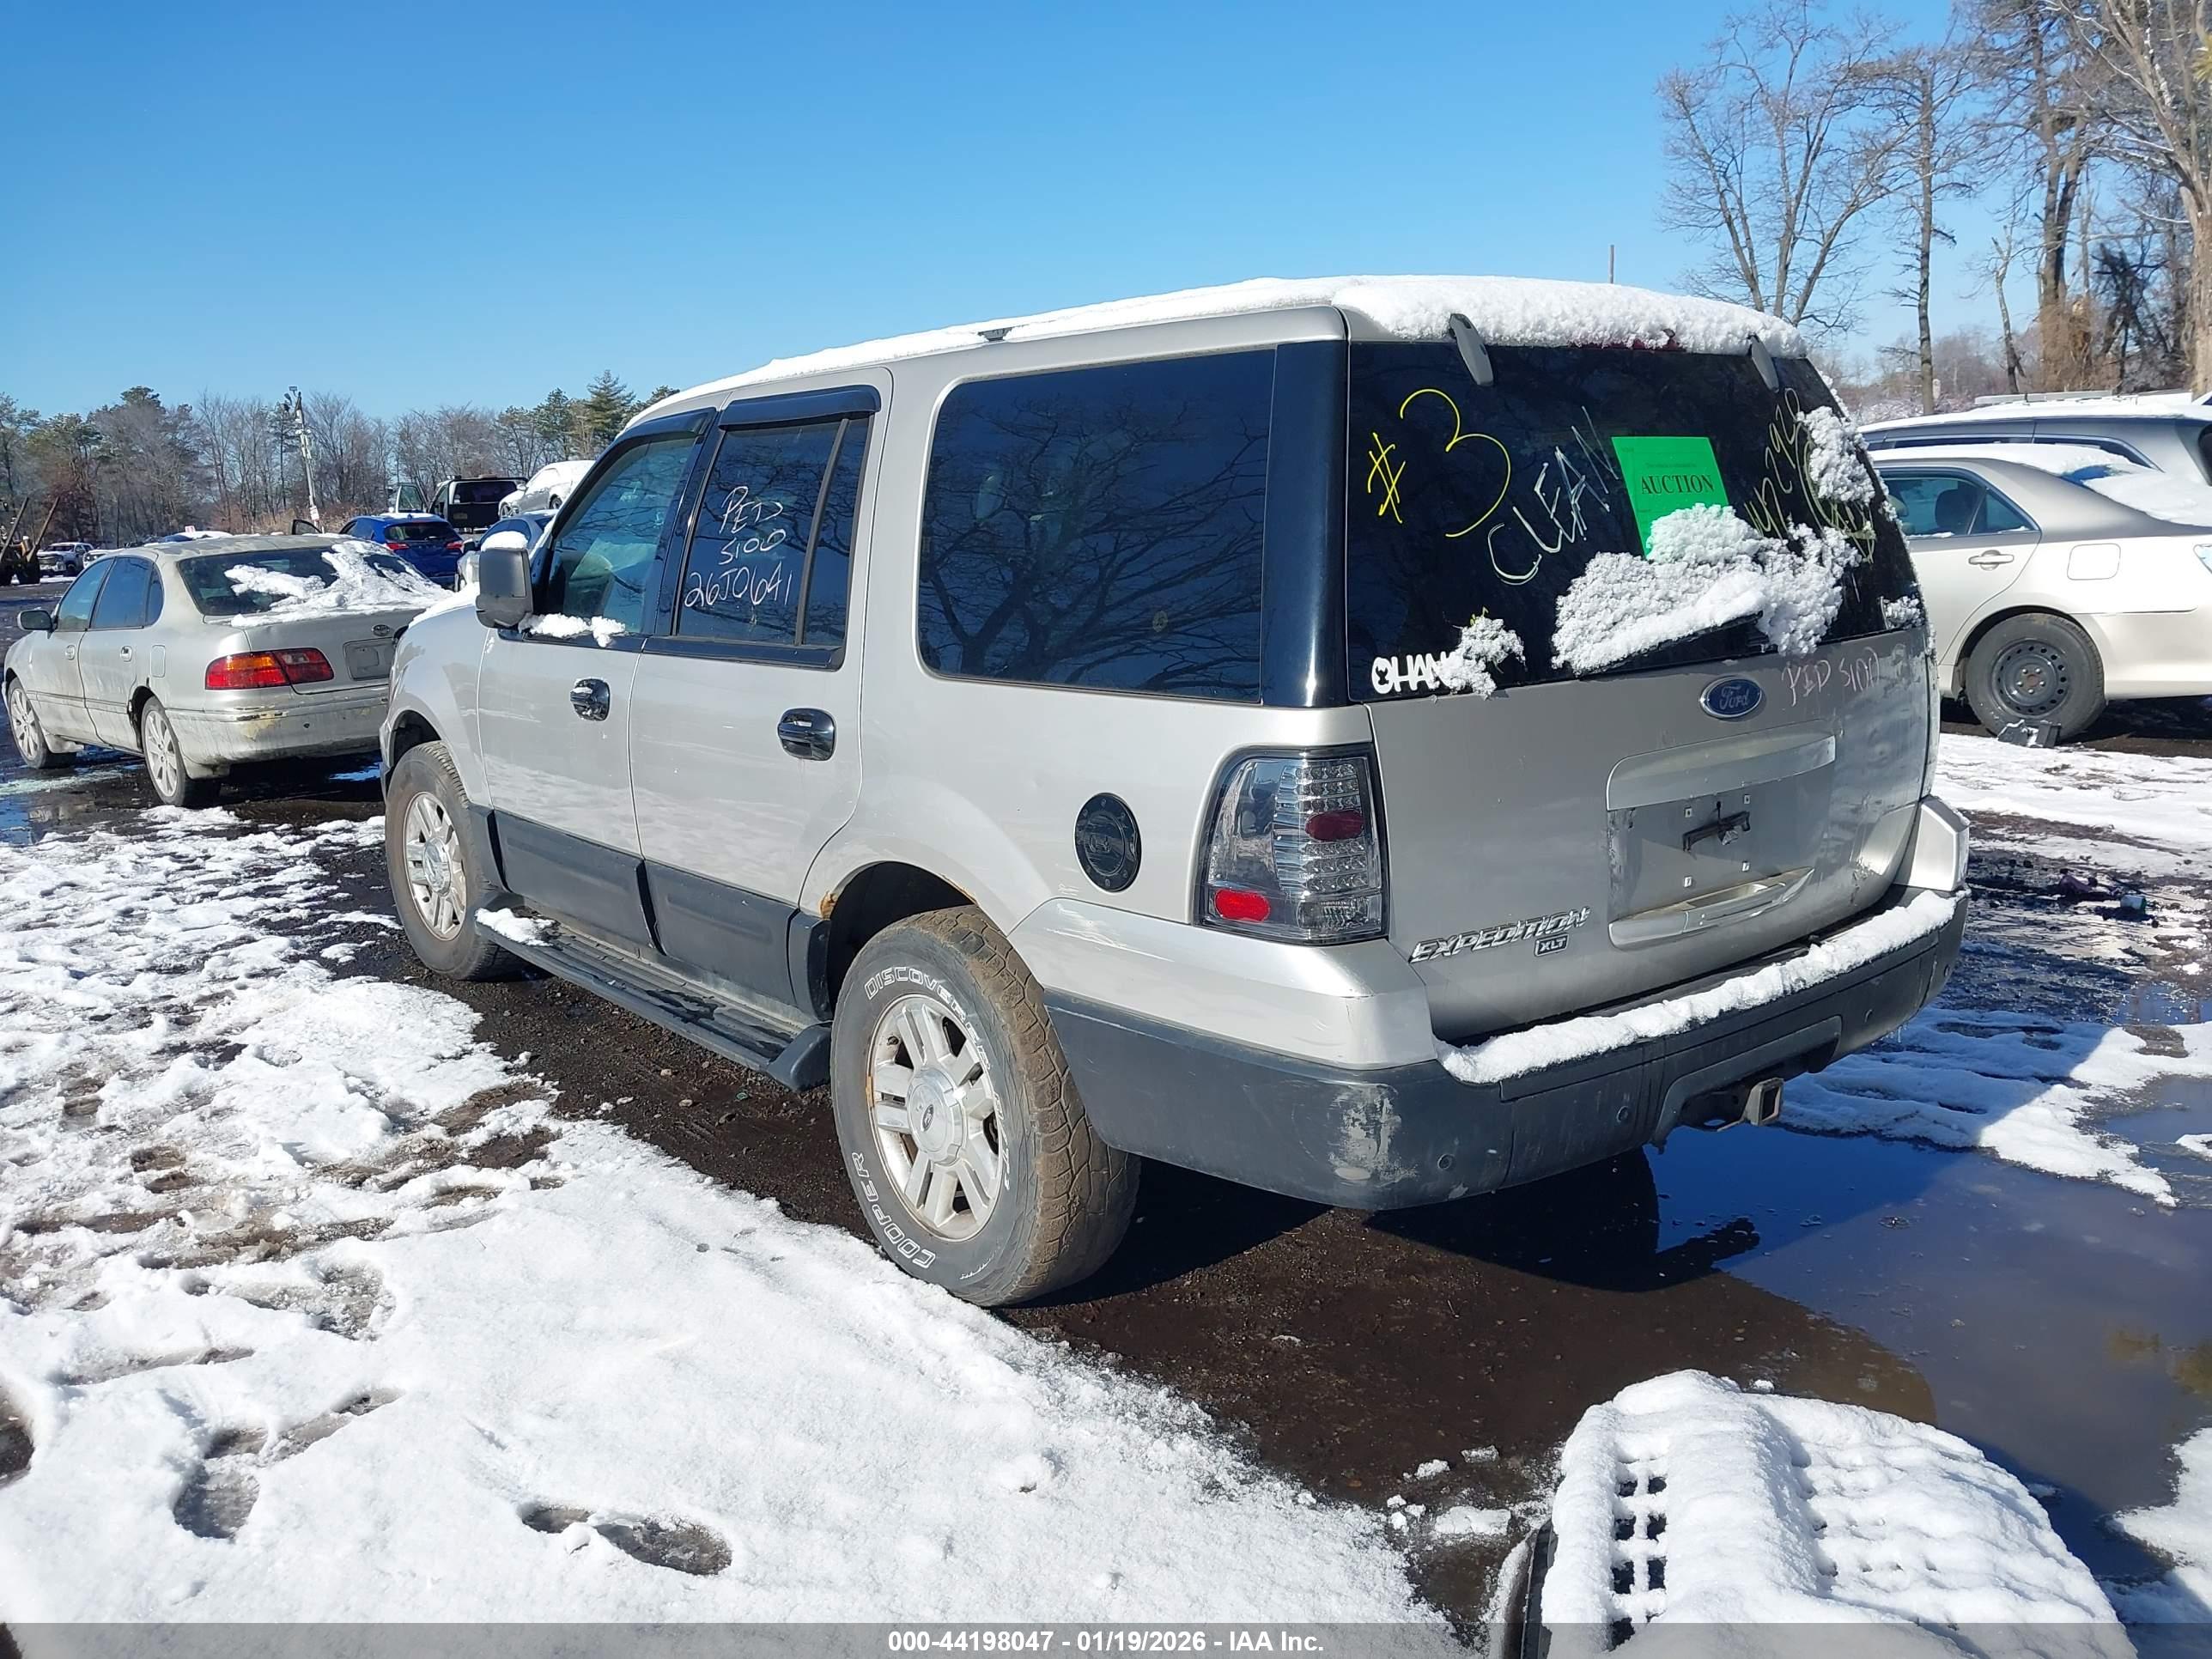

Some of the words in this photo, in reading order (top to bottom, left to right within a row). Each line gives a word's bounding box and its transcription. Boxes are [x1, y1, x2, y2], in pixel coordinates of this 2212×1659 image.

[1488, 405, 1620, 585] CLEAN
[1641, 474, 1715, 495] AUCTION
[1371, 650, 1457, 695] OHAN
[1719, 684, 1750, 709] Ford
[1408, 907, 1591, 963] EXPEDITION
[1539, 937, 1567, 952] XLT
[851, 1152, 937, 1269] COOPER
